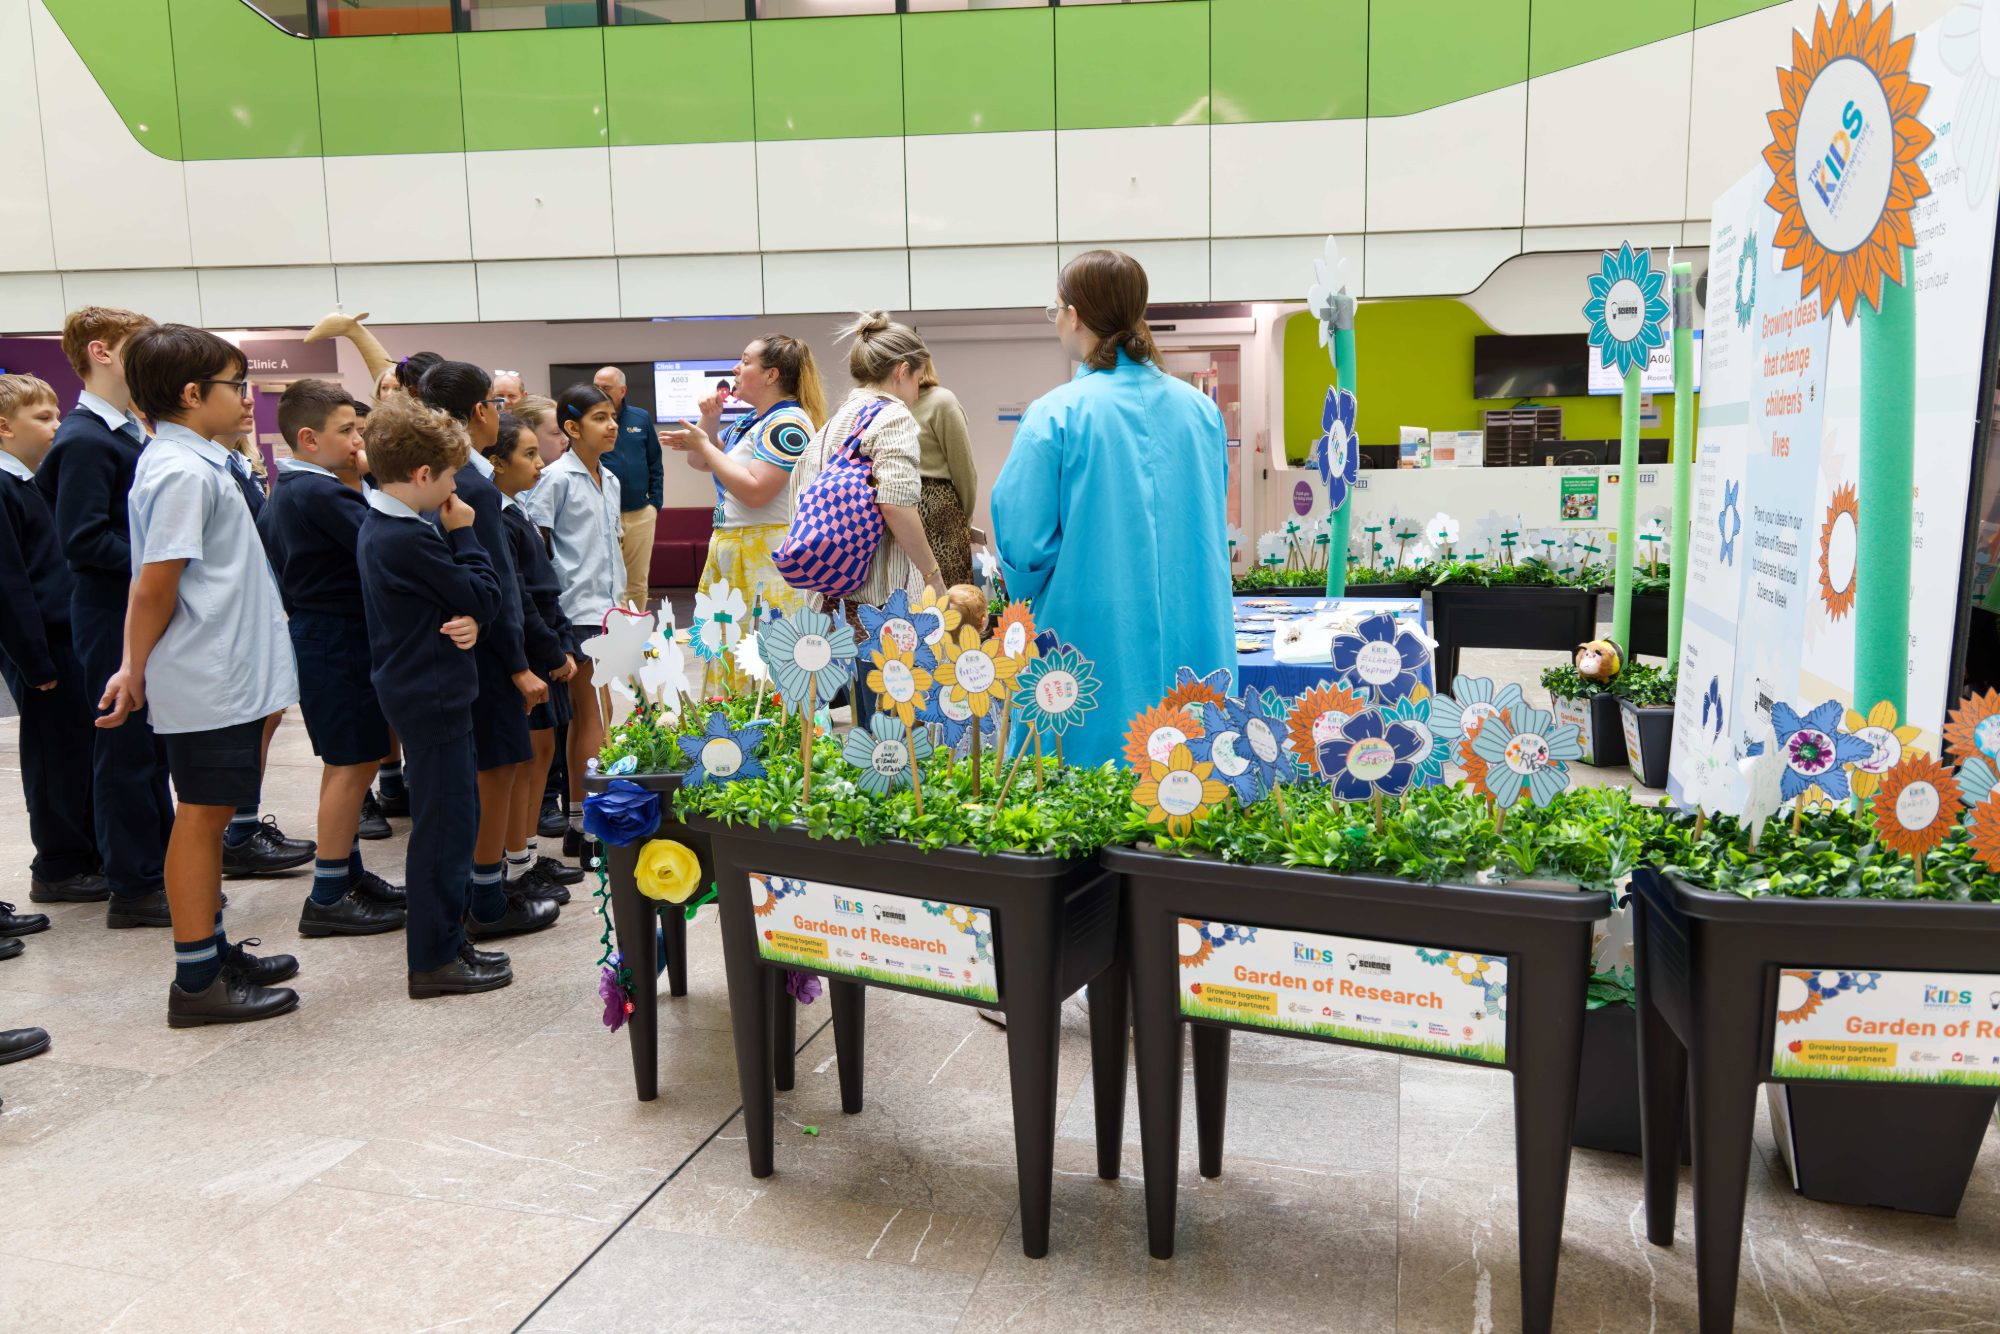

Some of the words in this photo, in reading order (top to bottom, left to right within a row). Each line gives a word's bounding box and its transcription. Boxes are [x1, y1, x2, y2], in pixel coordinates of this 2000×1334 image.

[1815, 100, 1863, 207] KIDS
[1762, 306, 1792, 339] Growing
[1794, 299, 1818, 329] ideas
[247, 359, 278, 370] Clinic
[280, 359, 289, 369] A
[1763, 351, 1779, 378] that
[1780, 346, 1810, 377] change
[1765, 385, 1802, 417] children's
[1771, 431, 1790, 457] lives
[834, 898, 864, 914] KIDS
[794, 914, 848, 937] Garden
[851, 926, 867, 941] of
[871, 927, 947, 955] Research
[1294, 947, 1333, 963] KIDS
[1206, 986, 1237, 998] Growing
[1238, 992, 1270, 1001] together
[1234, 965, 1307, 992] Garden
[1312, 977, 1335, 994] of
[1339, 979, 1444, 1010] Research
[1925, 990, 1972, 1004] KIDS
[1238, 1001, 1271, 1011] partners
[1846, 1016, 1936, 1037] Garden
[1943, 1020, 1969, 1038] of
[1808, 1042, 1846, 1053] Growing
[1848, 1045, 1888, 1054] together
[1808, 1053, 1828, 1061] with
[1847, 1055, 1887, 1063] partners
